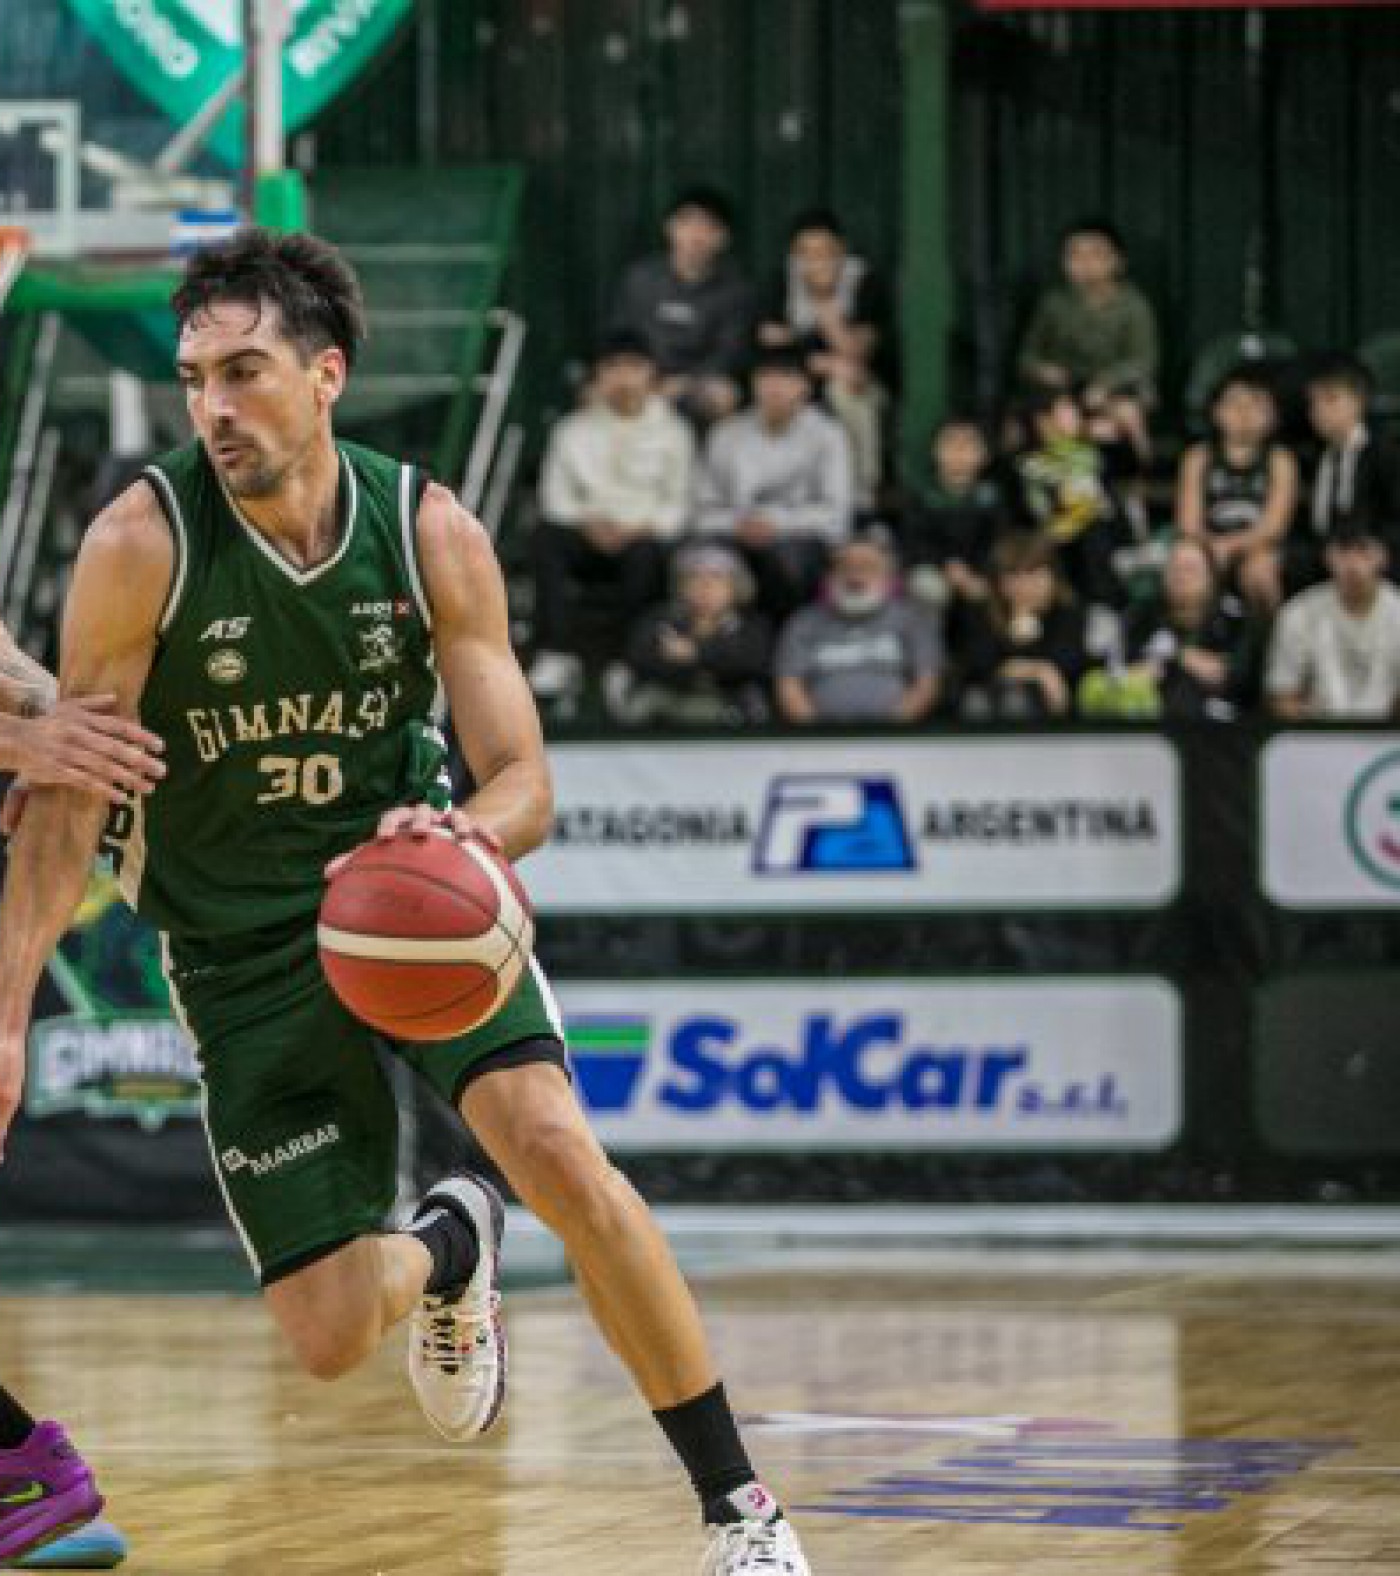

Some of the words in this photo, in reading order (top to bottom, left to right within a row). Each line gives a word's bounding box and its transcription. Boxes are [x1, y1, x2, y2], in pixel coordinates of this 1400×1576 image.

[256, 754, 345, 805] 30
[921, 800, 1158, 843] ARGENTINA
[661, 1010, 1024, 1114] SolCar
